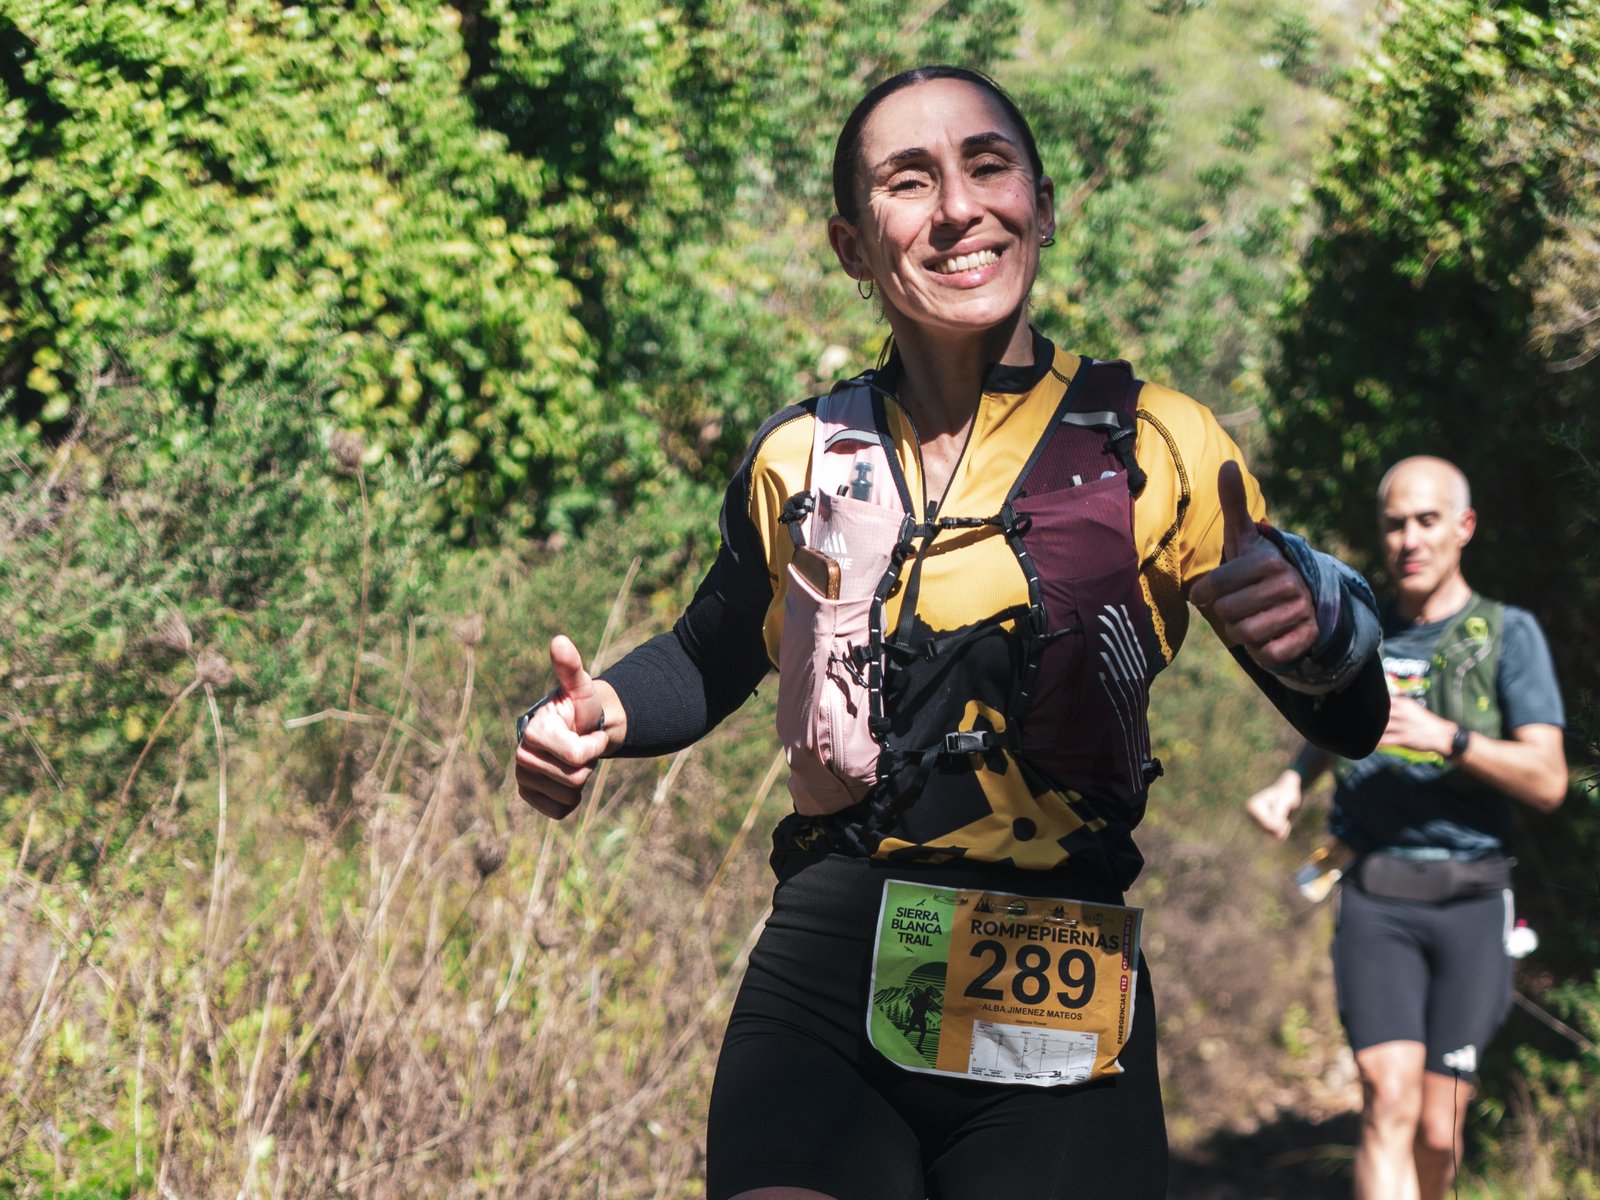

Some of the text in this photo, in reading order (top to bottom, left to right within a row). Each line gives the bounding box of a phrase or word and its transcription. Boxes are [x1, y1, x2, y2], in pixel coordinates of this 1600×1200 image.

[895, 906, 940, 923] SIERRA
[891, 918, 943, 936] BLANCA
[970, 919, 1120, 950] ROMPEPIERNAS
[897, 931, 933, 947] TRAIL
[964, 939, 1097, 1010] 289
[981, 1003, 1083, 1021] ALBA JIMENEZ MATEOS
[1117, 993, 1127, 1045] EMERGENCIAS
